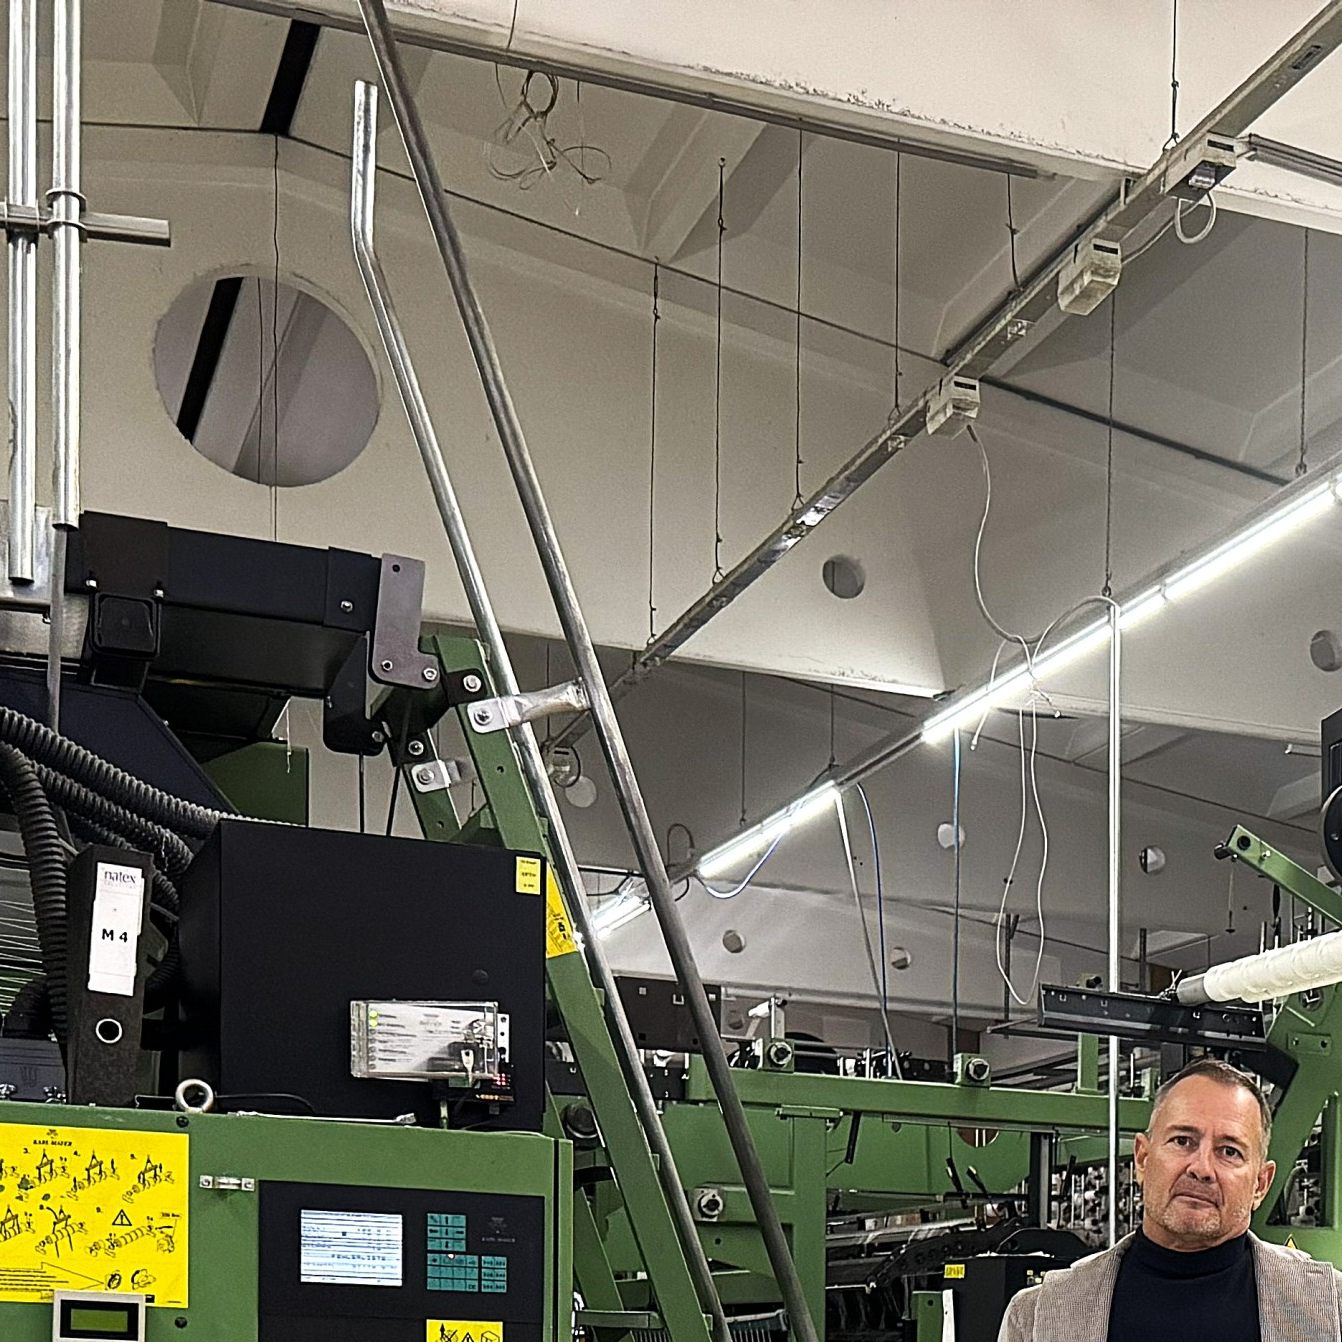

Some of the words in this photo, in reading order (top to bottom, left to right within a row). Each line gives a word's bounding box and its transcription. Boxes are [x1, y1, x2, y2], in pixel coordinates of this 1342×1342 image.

[104, 870, 137, 884] natex
[101, 928, 114, 942] M
[118, 931, 128, 943] 4
